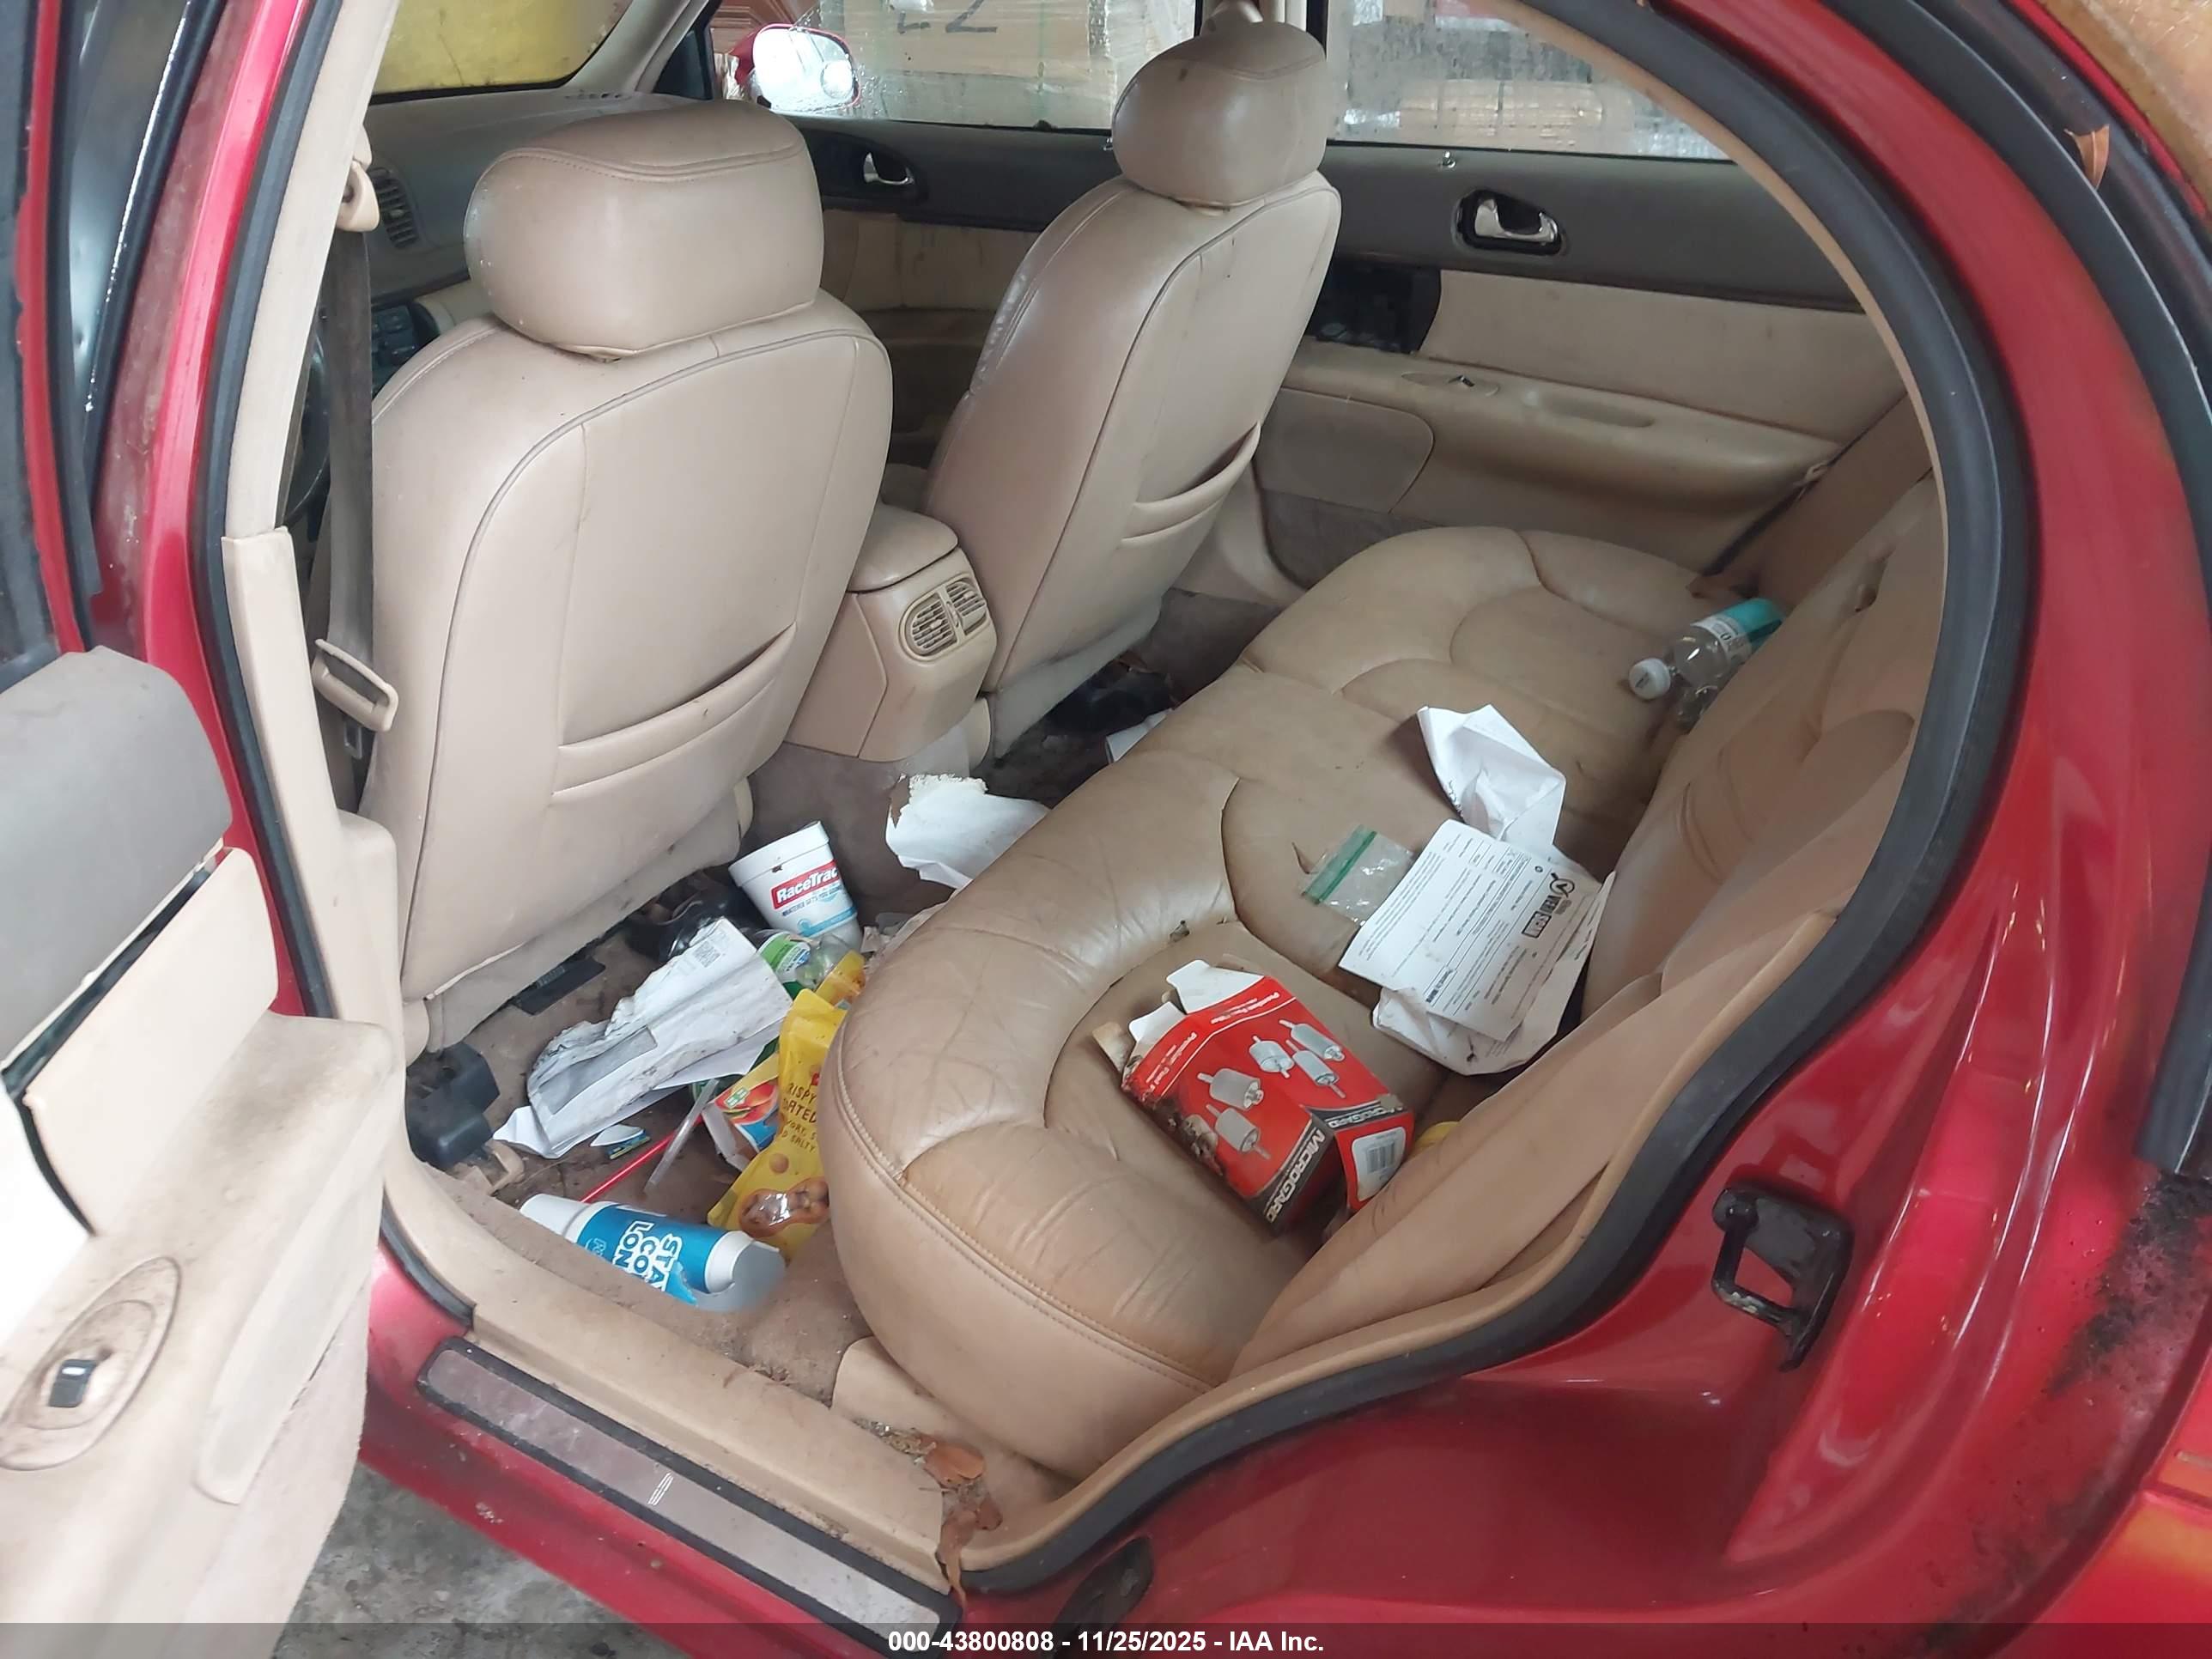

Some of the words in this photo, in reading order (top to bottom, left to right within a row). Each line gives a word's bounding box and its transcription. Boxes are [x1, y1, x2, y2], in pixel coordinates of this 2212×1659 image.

[777, 867, 838, 903] RaceTrac
[1328, 1106, 1402, 1128] CROGARD
[791, 1134, 816, 1152] SALTY
